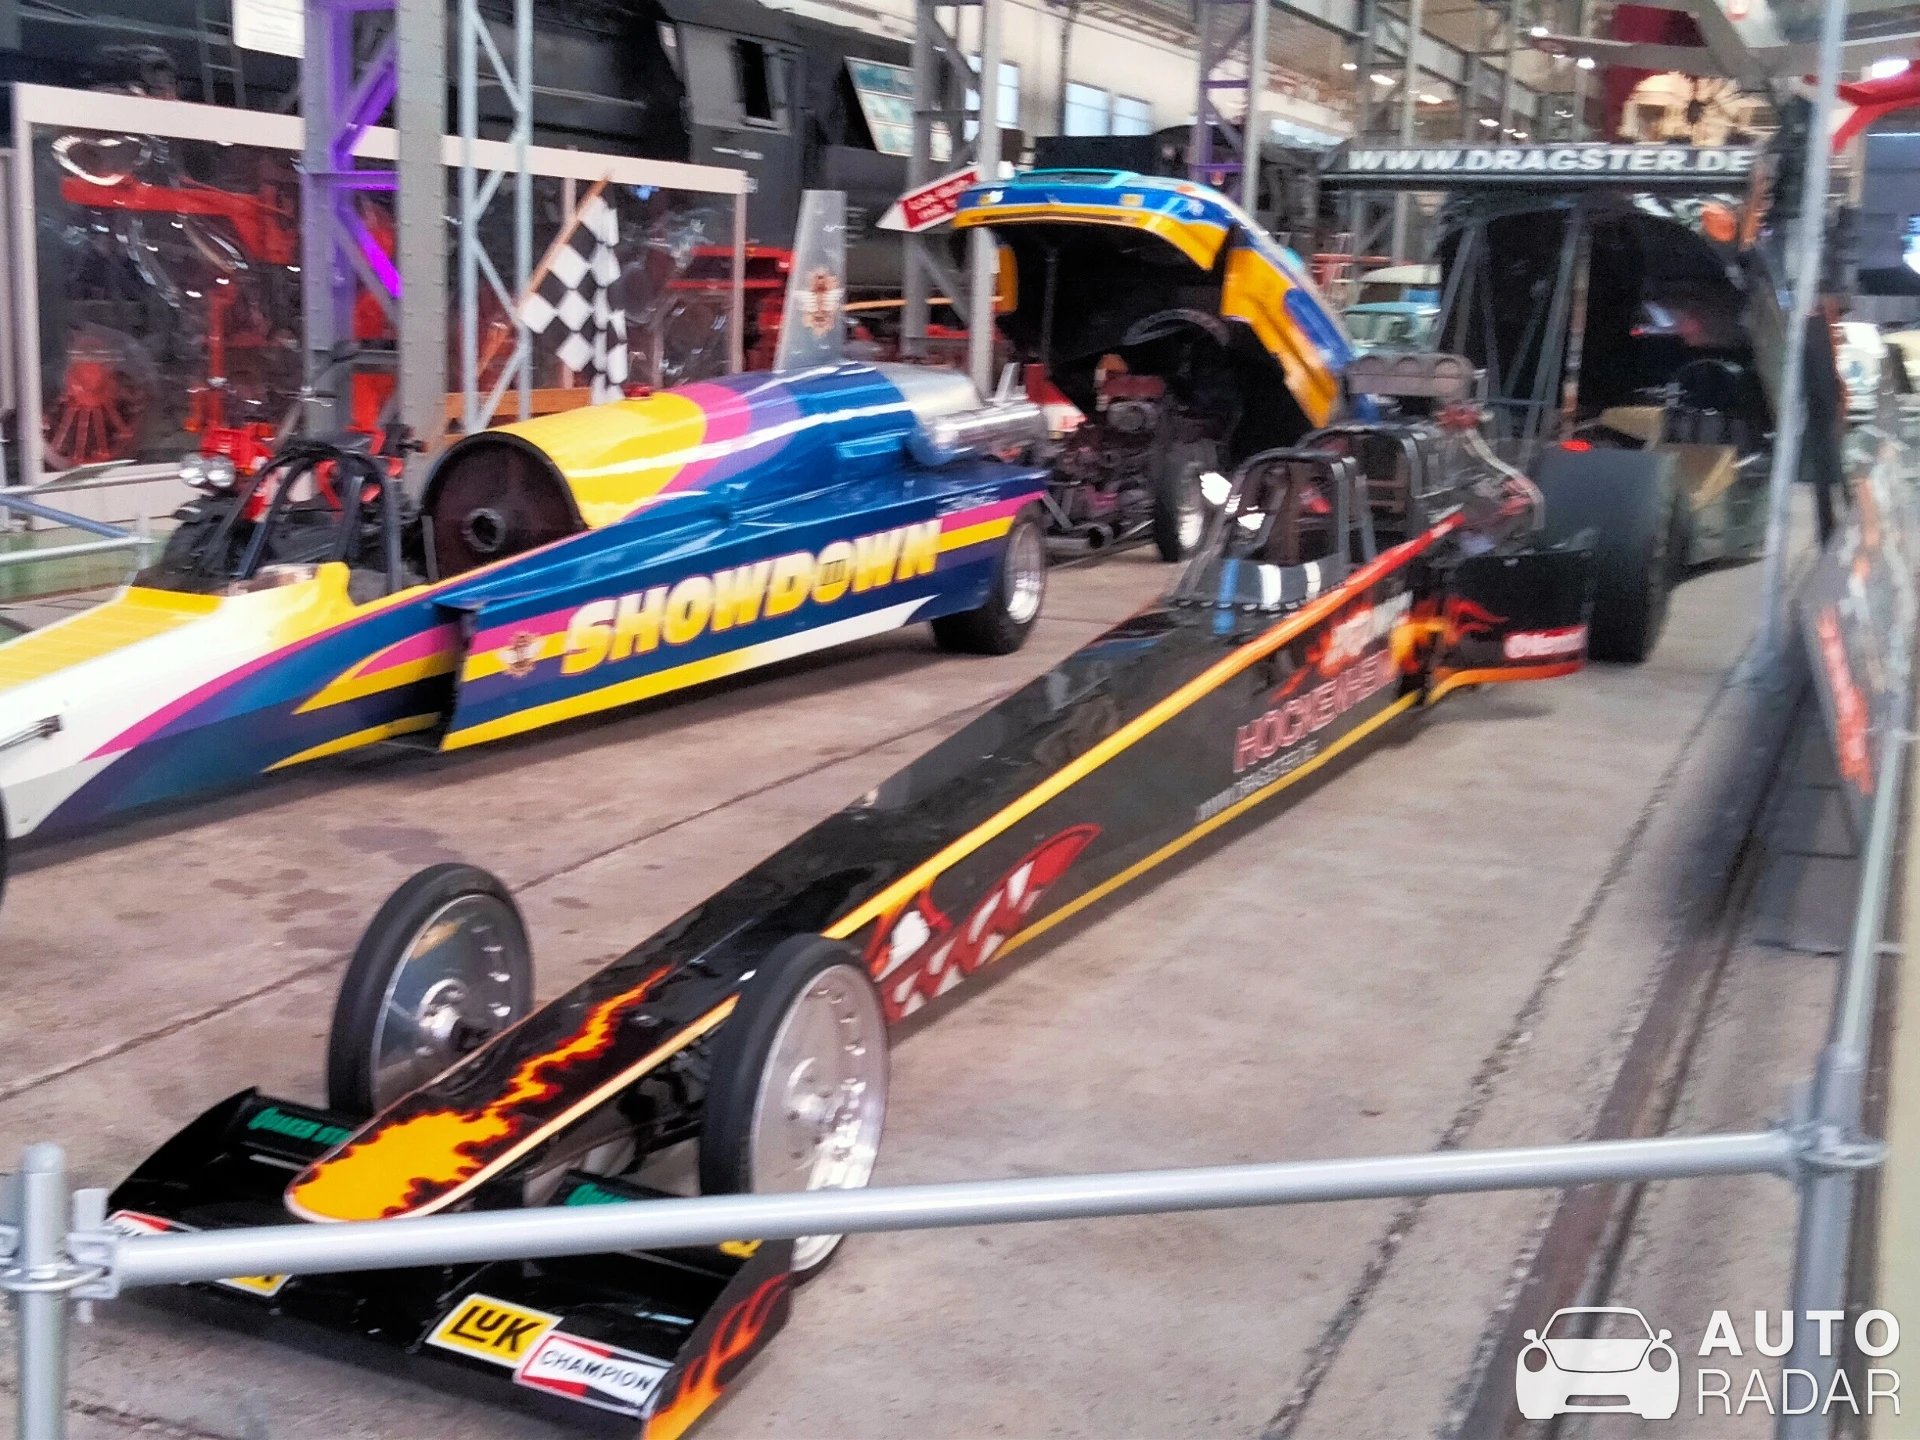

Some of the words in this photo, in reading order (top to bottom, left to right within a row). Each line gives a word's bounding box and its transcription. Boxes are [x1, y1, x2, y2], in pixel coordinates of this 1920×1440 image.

[1346, 149, 1754, 171] WWW.DRAGSTER.DE
[560, 518, 943, 676] SHOWDOWN
[540, 1349, 655, 1391] CHAMPION
